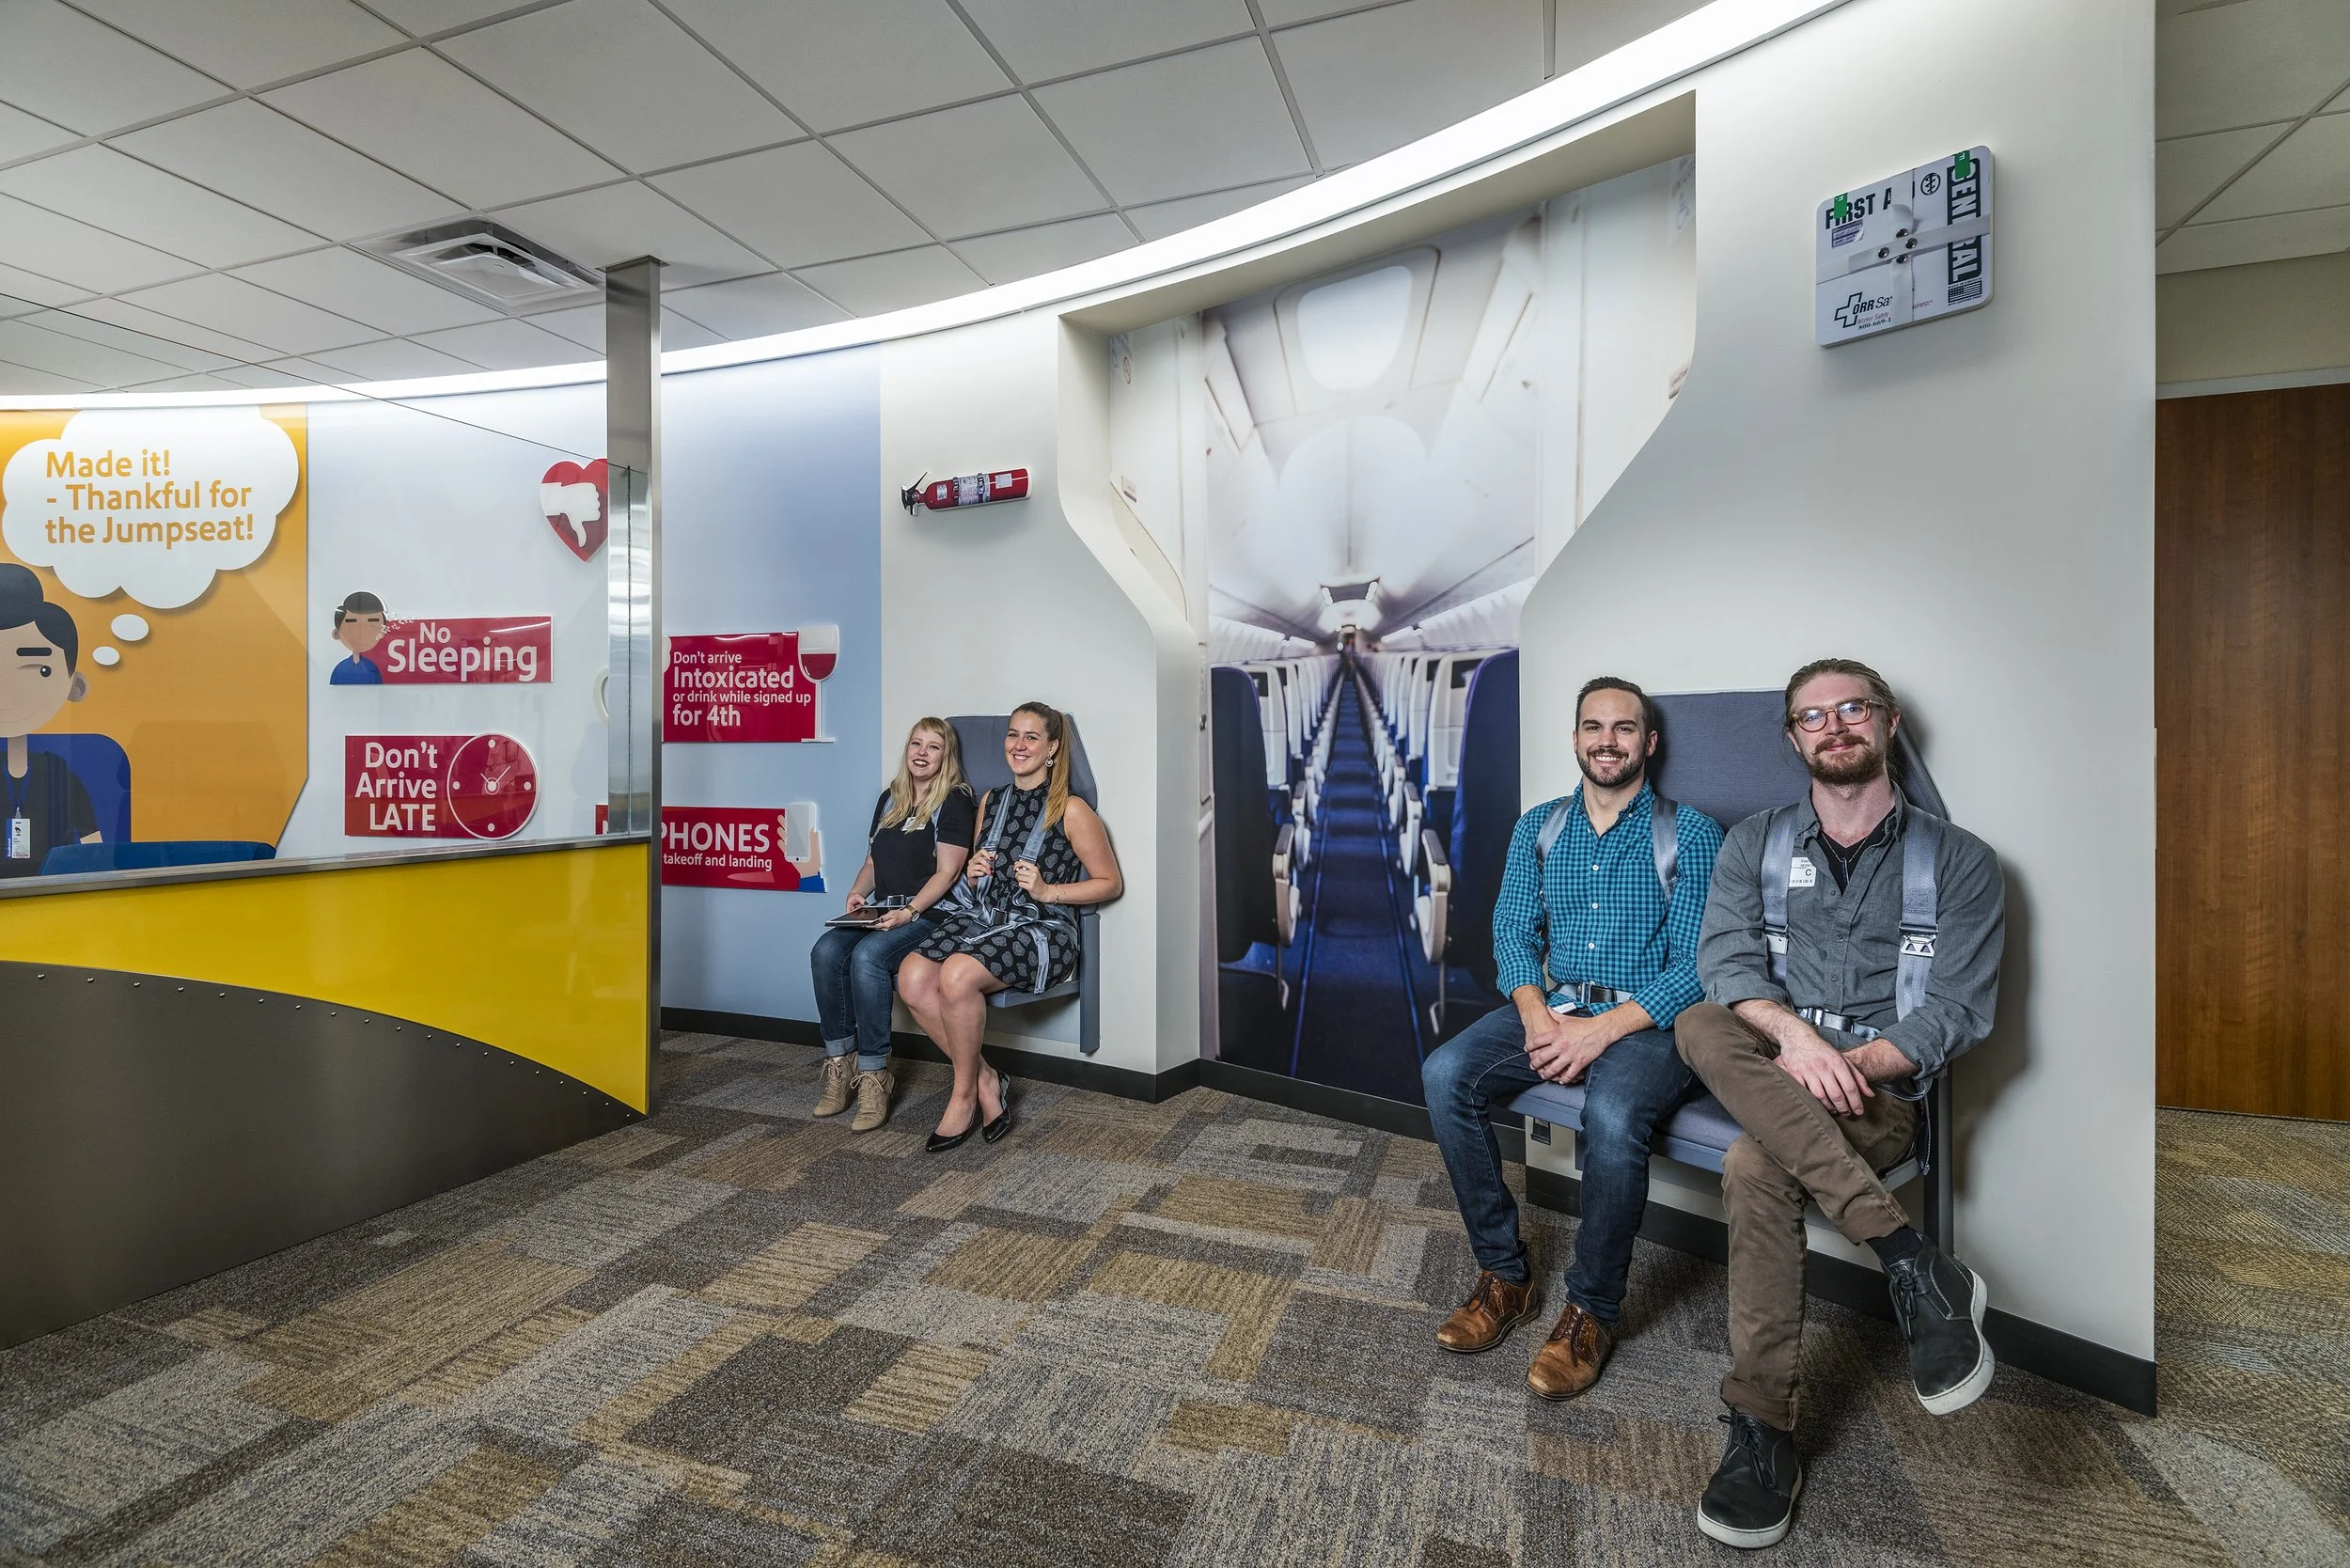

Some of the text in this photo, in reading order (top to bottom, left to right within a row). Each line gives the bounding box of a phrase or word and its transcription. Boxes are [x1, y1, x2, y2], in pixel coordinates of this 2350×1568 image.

[1852, 299, 1875, 315] ORR
[46, 448, 170, 478] Made it!
[65, 480, 200, 510] Thankful
[209, 479, 252, 509] for
[45, 513, 254, 550] the Jumpseat!
[419, 621, 451, 644] No
[386, 635, 538, 682] Sleeping
[673, 651, 743, 665] Don't arrive
[673, 665, 794, 689] Intoxicated
[672, 689, 811, 706] or drink while signed up
[672, 704, 741, 726] for 4th
[365, 741, 438, 768] Don't
[354, 771, 437, 799] Arrive
[369, 803, 436, 832] LATE
[663, 853, 773, 871] takeoff and landing
